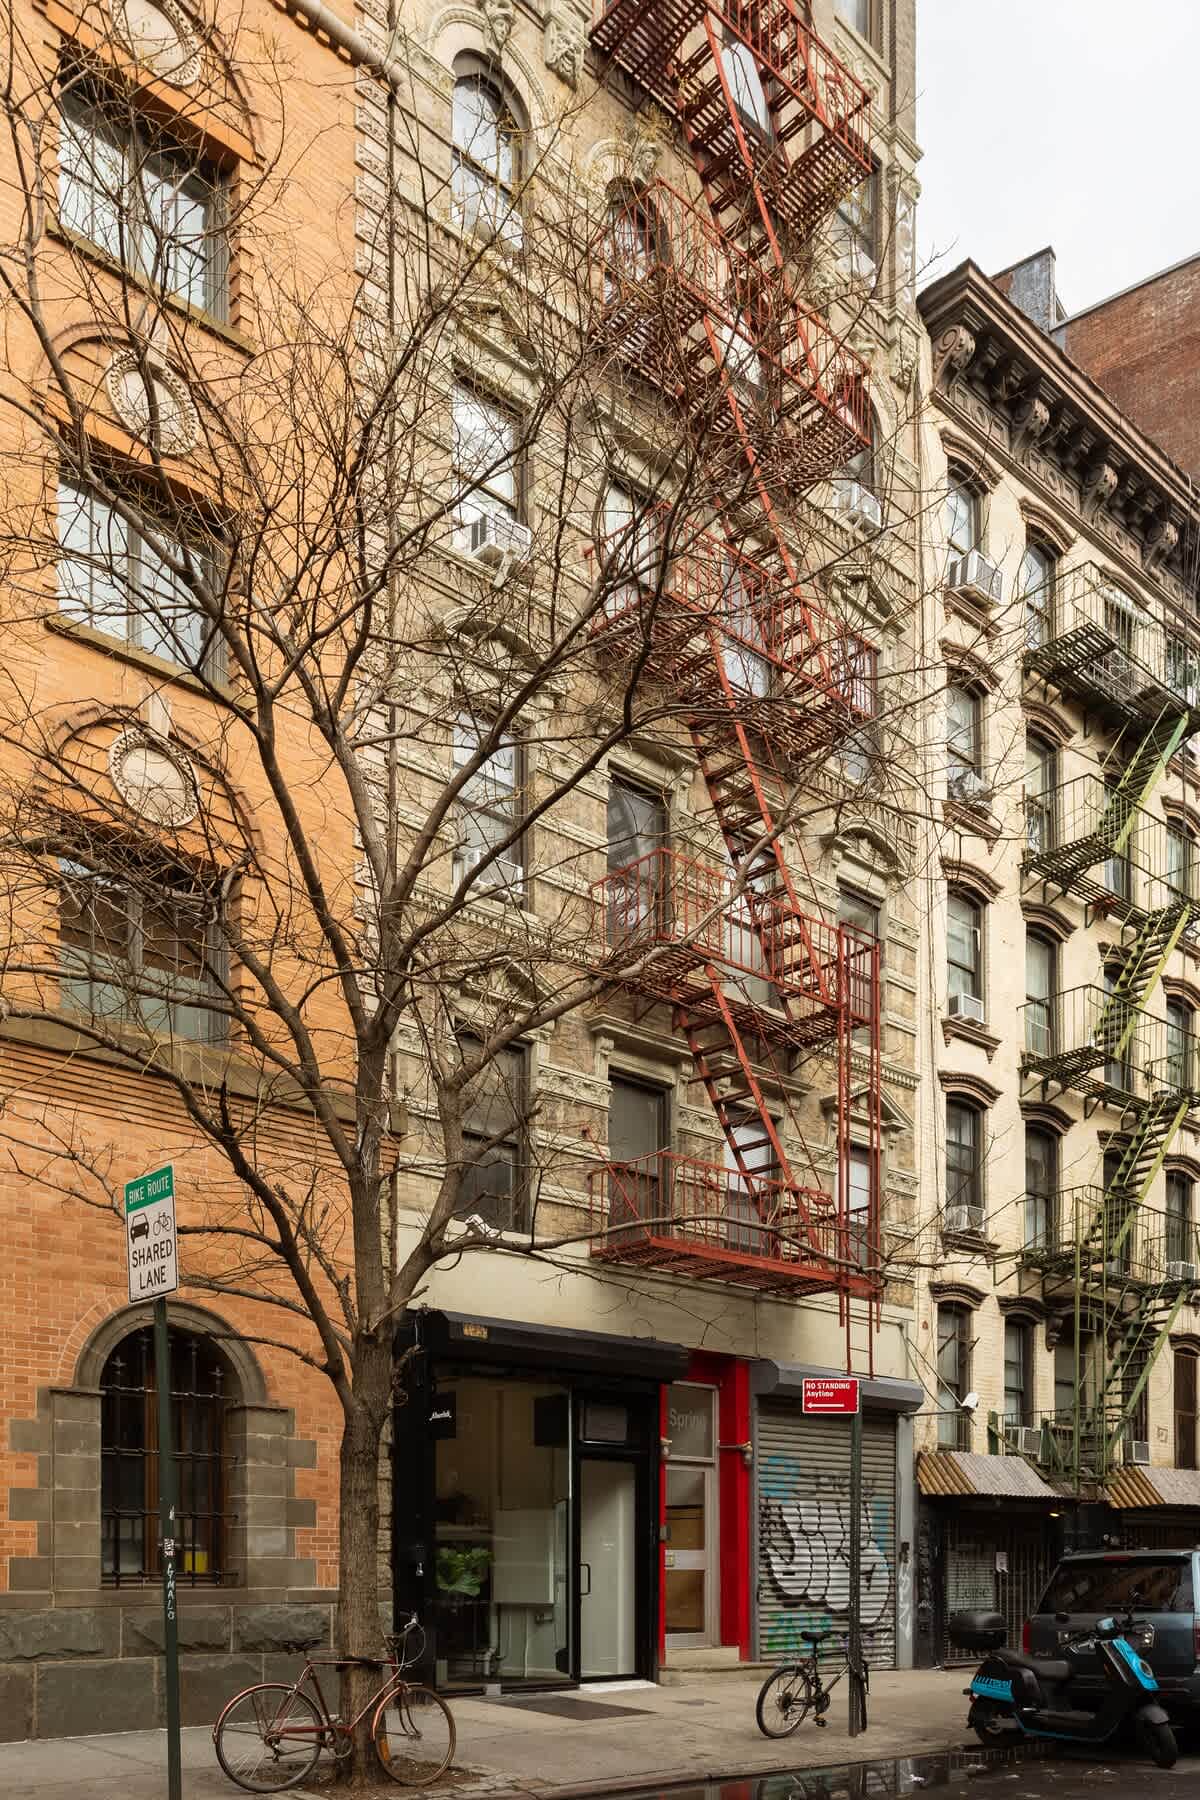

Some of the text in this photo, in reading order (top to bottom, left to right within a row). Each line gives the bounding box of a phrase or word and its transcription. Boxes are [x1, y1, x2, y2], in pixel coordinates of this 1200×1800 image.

[129, 1176, 170, 1204] BIKE ROUTE
[132, 1239, 173, 1268] SHARED
[139, 1266, 167, 1290] LANE
[806, 1382, 850, 1390] NO STANDING
[806, 1390, 834, 1398] Anytime
